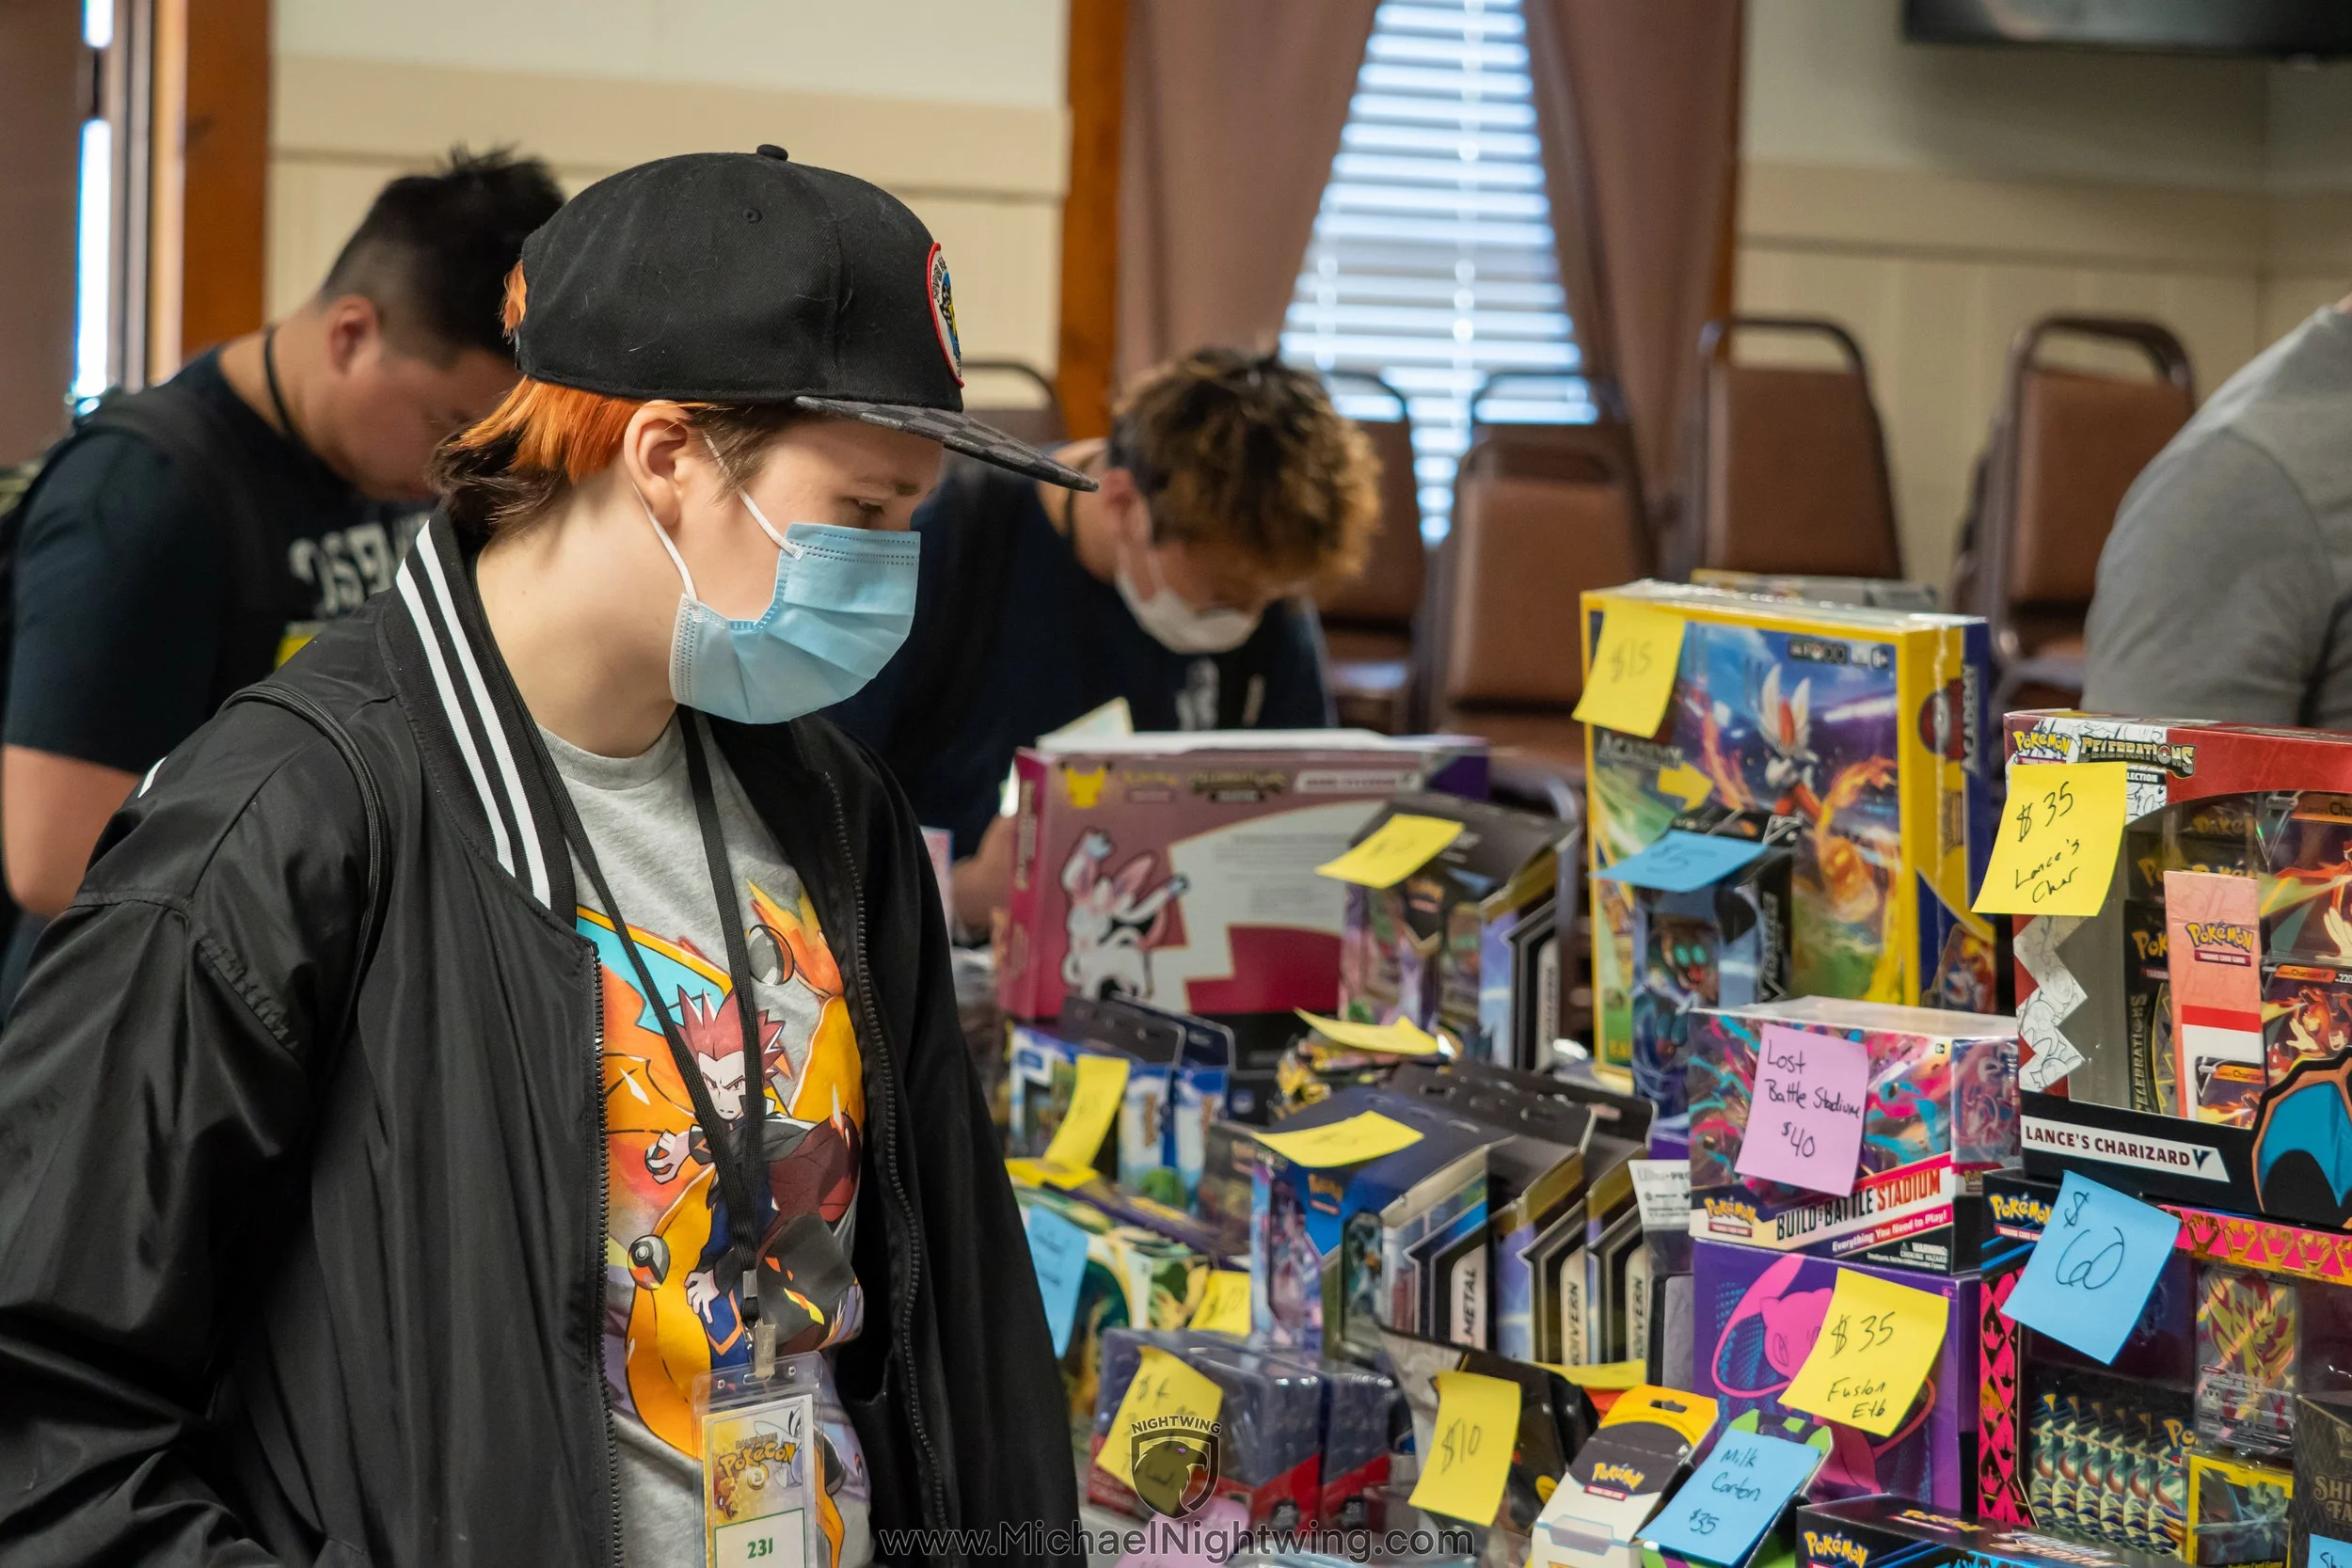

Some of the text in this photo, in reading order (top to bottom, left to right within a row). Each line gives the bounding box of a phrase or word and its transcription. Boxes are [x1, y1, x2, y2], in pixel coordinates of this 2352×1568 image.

[2042, 781, 2074, 827] 35
[1767, 1038, 1806, 1074] Lost
[1764, 1079, 1860, 1119] Battle Stadium
[1781, 1121, 1816, 1158] $40
[2026, 1125, 2090, 1149] LANCE'S
[2094, 1138, 2191, 1166] CHARIZARD
[1776, 1203, 1818, 1242] BUILD
[1824, 1186, 1873, 1227] BATTLE
[1876, 1168, 1941, 1212] STADIUM
[1831, 1210, 1947, 1252] Everything You Need to Play!
[2056, 1226, 2124, 1290] 60
[1463, 1269, 1476, 1343] METAL
[1858, 1311, 1896, 1353] 35
[1440, 1418, 1482, 1475] $10
[1720, 1448, 1759, 1468] Milk
[1711, 1473, 1761, 1502] Carton
[1689, 1507, 1721, 1535] $35
[747, 1537, 773, 1560] 231
